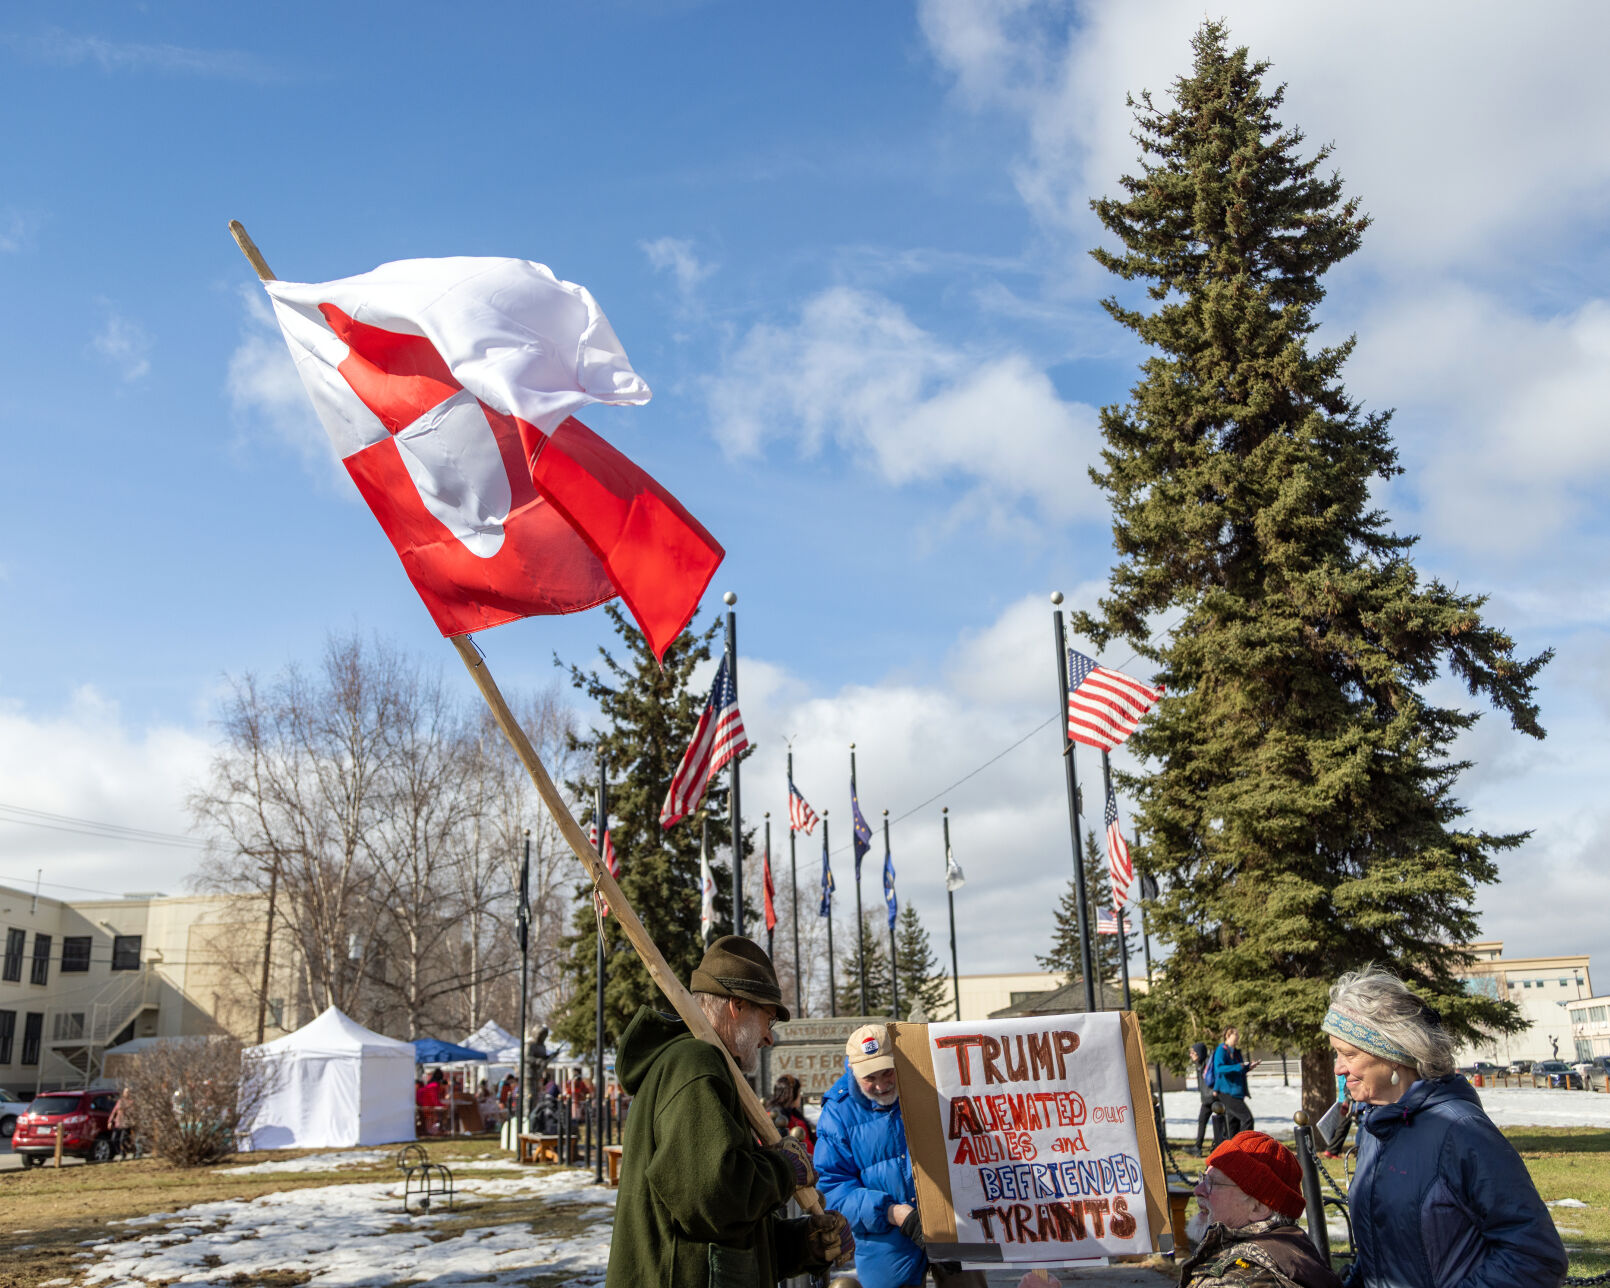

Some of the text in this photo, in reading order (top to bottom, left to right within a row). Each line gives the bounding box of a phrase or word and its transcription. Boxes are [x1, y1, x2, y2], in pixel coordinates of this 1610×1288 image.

[784, 1026, 836, 1036] INTERIOR
[779, 1054, 843, 1069] VETER
[934, 1030, 1080, 1086] TRUMP
[949, 1091, 1128, 1140] ALIENATED our
[953, 1129, 1091, 1165] ALLIES and
[979, 1153, 1143, 1201] BEFRIENDED
[968, 1196, 1137, 1243] TYRANTS
